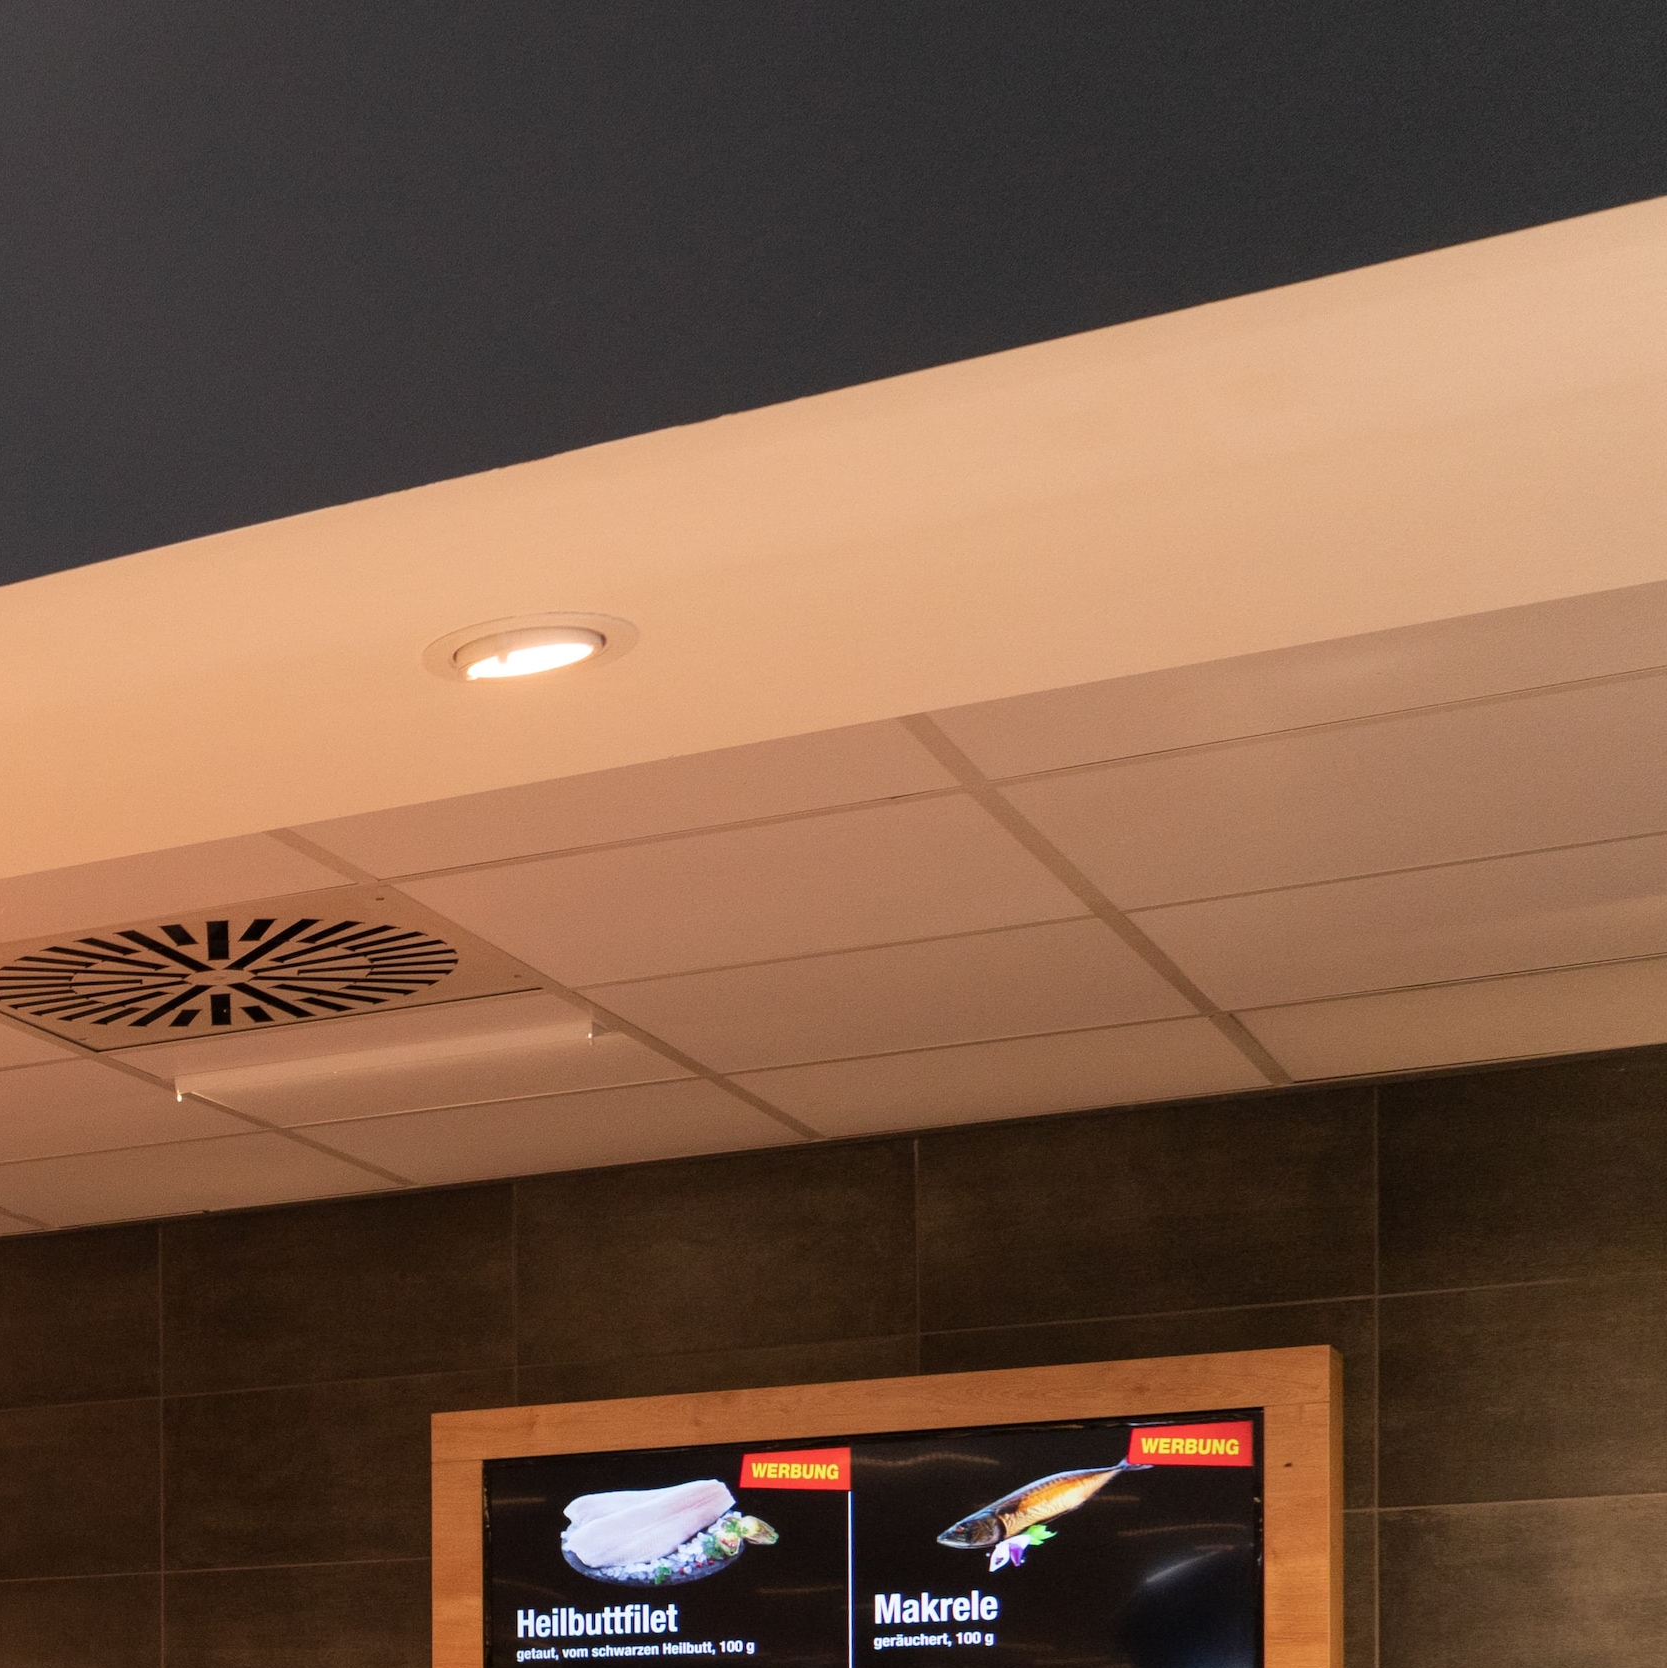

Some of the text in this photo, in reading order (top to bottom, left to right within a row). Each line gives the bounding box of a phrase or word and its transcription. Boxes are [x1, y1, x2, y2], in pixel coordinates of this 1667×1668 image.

[1141, 1435, 1241, 1459] WERBUNG
[751, 1461, 840, 1484] WERBUNG
[873, 1590, 1000, 1625] Makrele
[516, 1602, 679, 1639] Heilbuttfilet
[516, 1640, 756, 1662] getaut, vom schwarzen Heilbutt, 100 g
[873, 1631, 995, 1650] geräuchert, 100 g
